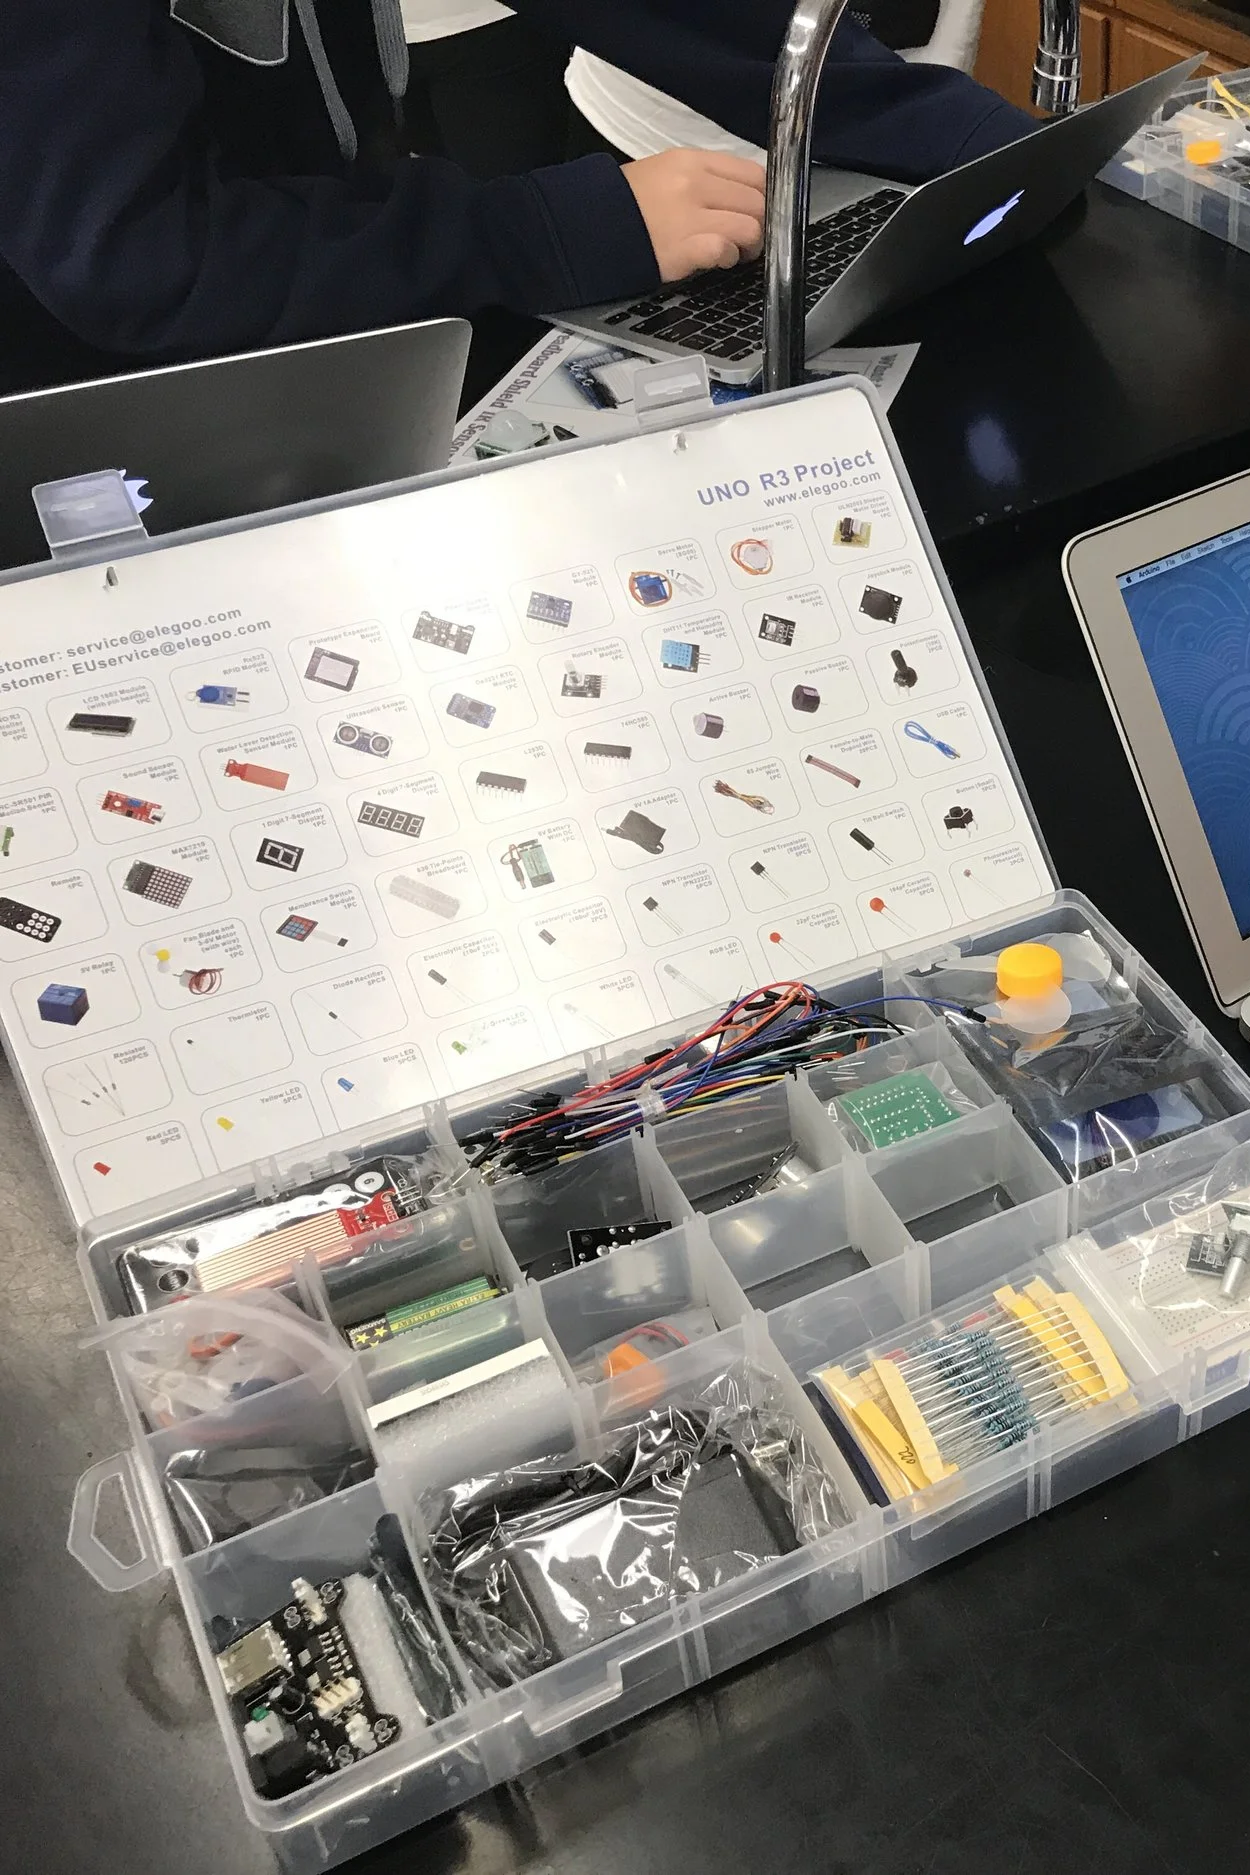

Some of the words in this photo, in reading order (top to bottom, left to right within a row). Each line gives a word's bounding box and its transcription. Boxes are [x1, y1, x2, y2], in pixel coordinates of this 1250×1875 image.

[517, 330, 576, 379] readboard
[489, 376, 531, 409] Shield
[449, 423, 487, 456] Senso
[695, 477, 752, 506] UNO
[757, 468, 791, 491] R3
[792, 448, 877, 485] Project
[762, 470, 882, 510] www.elegoo.com
[1138, 564, 1161, 579] Arduino
[1165, 557, 1176, 567] File
[1180, 551, 1192, 561] Edit
[1220, 535, 1234, 545] Tools
[1238, 528, 1250, 539] Help
[64, 606, 243, 659] service@elegoo.com
[71, 618, 272, 677] EUservice@elegoo.com
[0, 669, 69, 694] stomer:
[118, 683, 146, 695] Module
[723, 941, 737, 950] LED
[617, 975, 632, 985] LED
[382, 1052, 399, 1063] Blue
[398, 1047, 414, 1058] LED
[260, 1091, 285, 1104] Yellow
[284, 1085, 300, 1096] LED
[161, 1125, 179, 1137] LED
[395, 1311, 431, 1328] BATTERY
[432, 1302, 458, 1315] HEAVY
